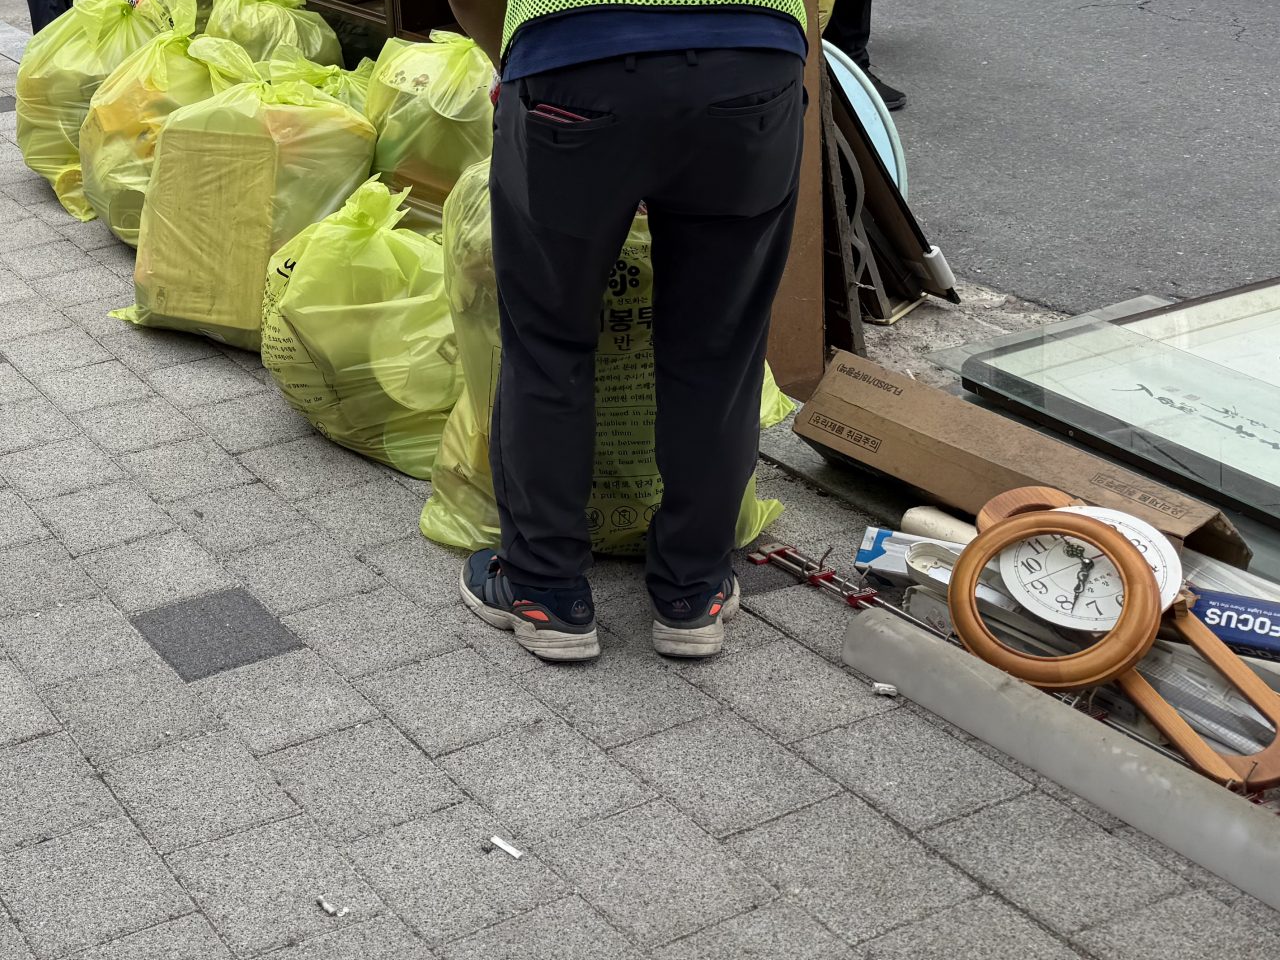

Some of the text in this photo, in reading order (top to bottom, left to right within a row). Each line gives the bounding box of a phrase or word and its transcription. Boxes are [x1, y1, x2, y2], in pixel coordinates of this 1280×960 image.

[846, 429, 880, 450] 취급주의
[1026, 538, 1050, 556] 11
[1020, 557, 1043, 575] 10
[1030, 580, 1049, 595] 9
[1055, 594, 1074, 610] 8
[1085, 600, 1104, 616] 7
[1204, 608, 1280, 637] FOCUS
